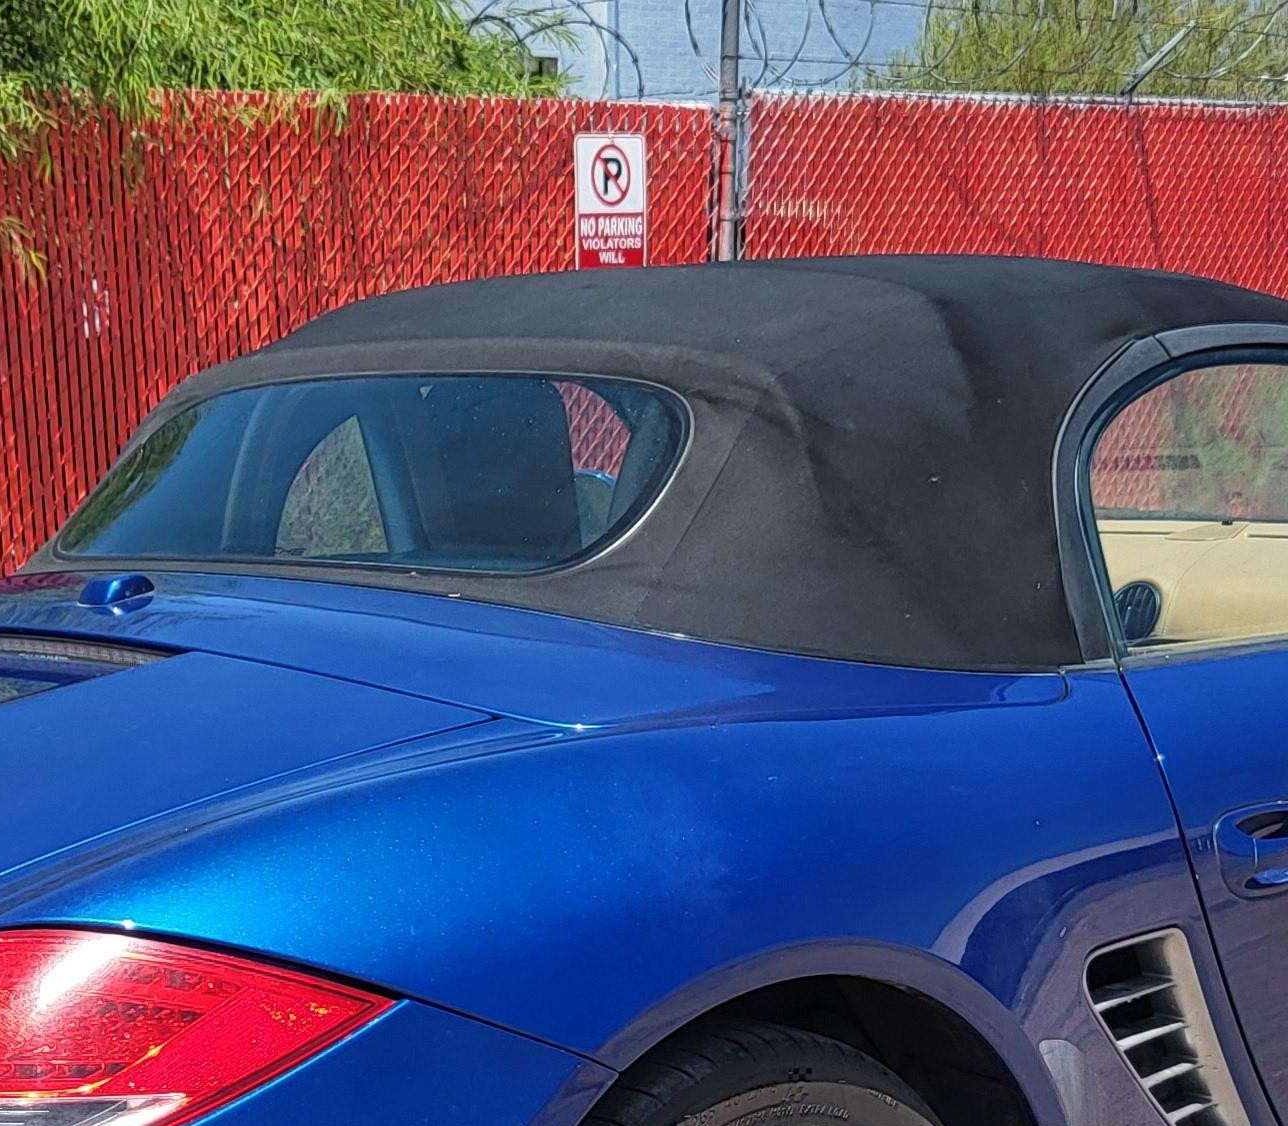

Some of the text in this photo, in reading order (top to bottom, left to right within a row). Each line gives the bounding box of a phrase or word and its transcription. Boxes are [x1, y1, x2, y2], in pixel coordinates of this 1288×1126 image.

[580, 215, 643, 238] NO PARKING
[582, 237, 642, 250] VIOLATORS
[599, 251, 626, 264] WILL
